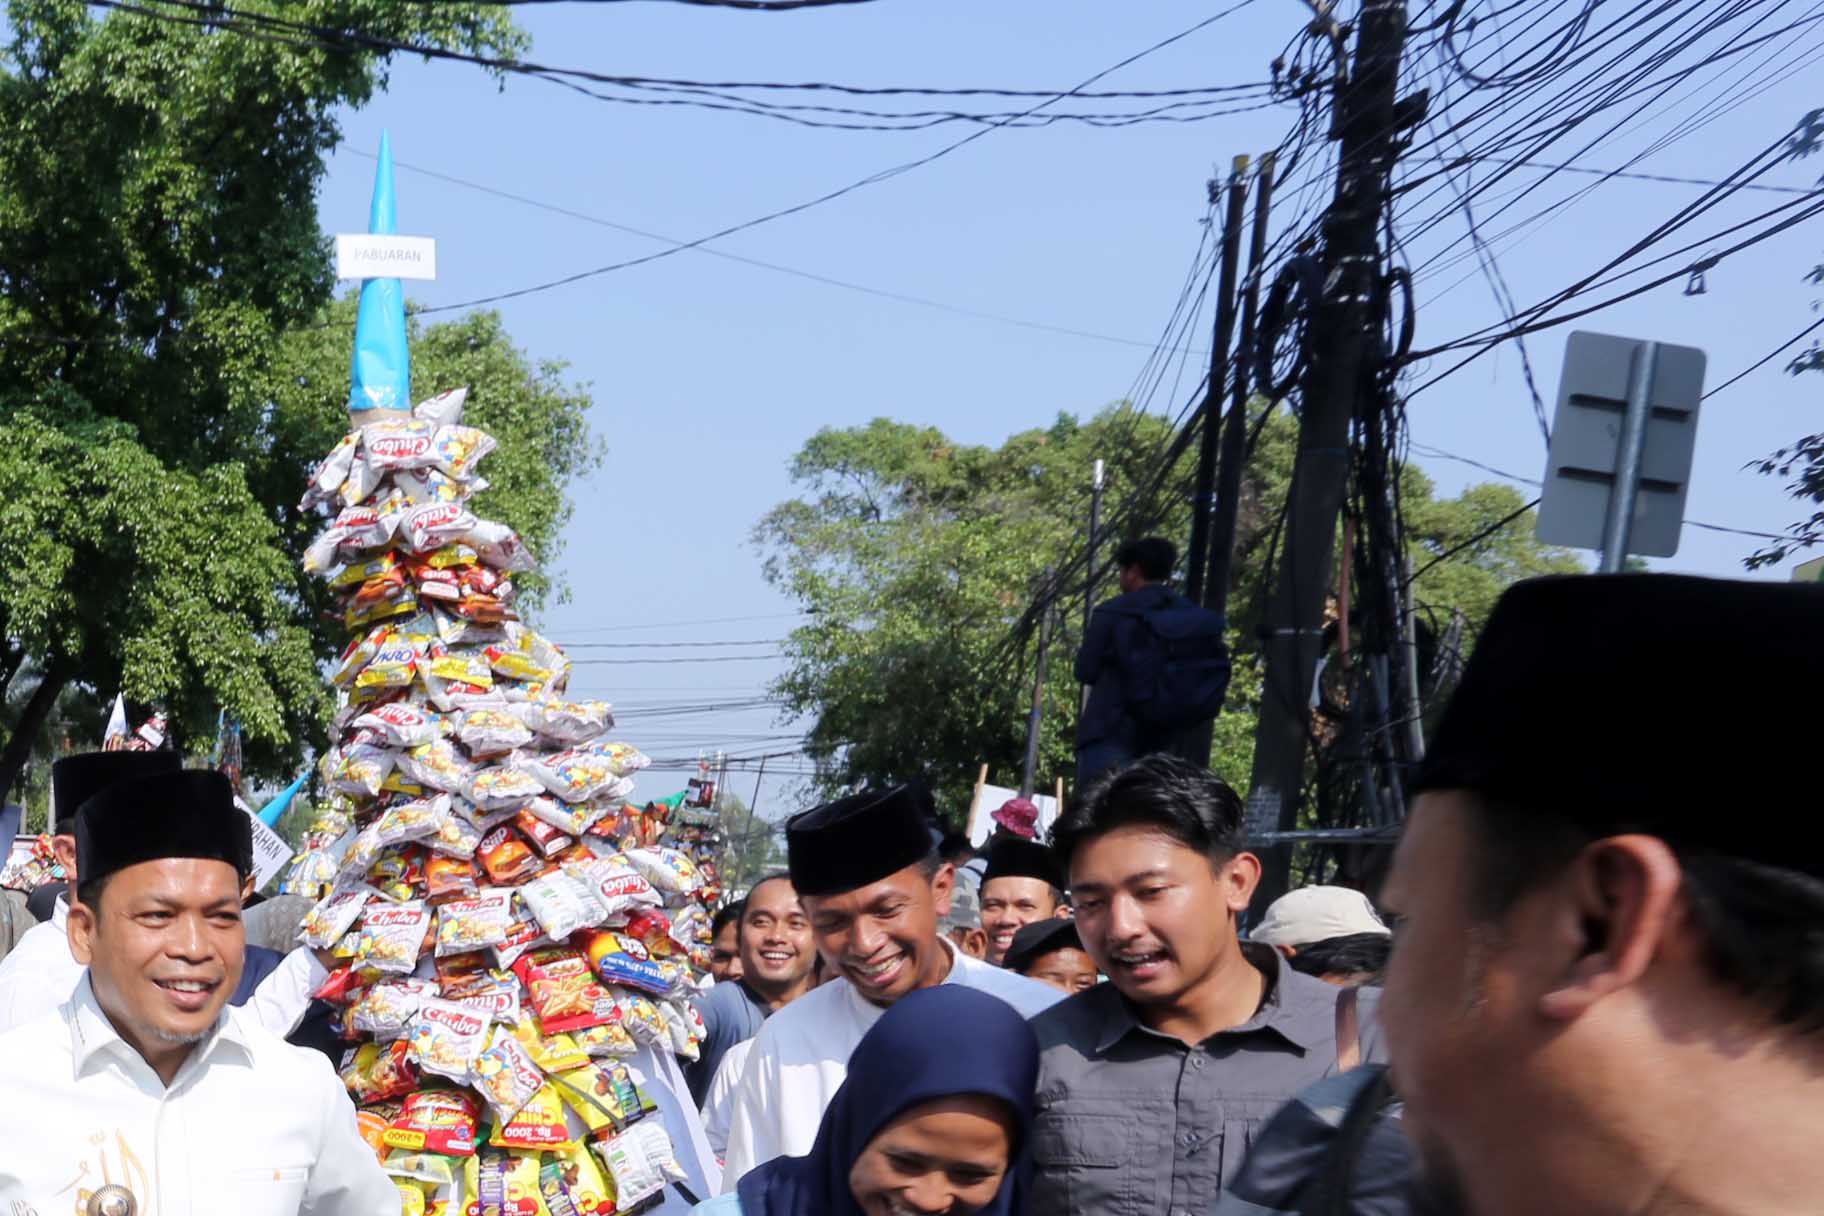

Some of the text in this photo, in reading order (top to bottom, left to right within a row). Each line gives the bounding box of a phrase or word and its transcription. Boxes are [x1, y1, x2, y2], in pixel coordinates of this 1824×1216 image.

[354, 247, 422, 262] PABUARAN
[251, 817, 283, 862] RAHAN
[603, 876, 650, 894] Chuba
[367, 910, 419, 926] Chuba
[423, 1008, 481, 1035] Chuba
[512, 1106, 559, 1126] CHIK
[504, 1127, 533, 1138] 2000
